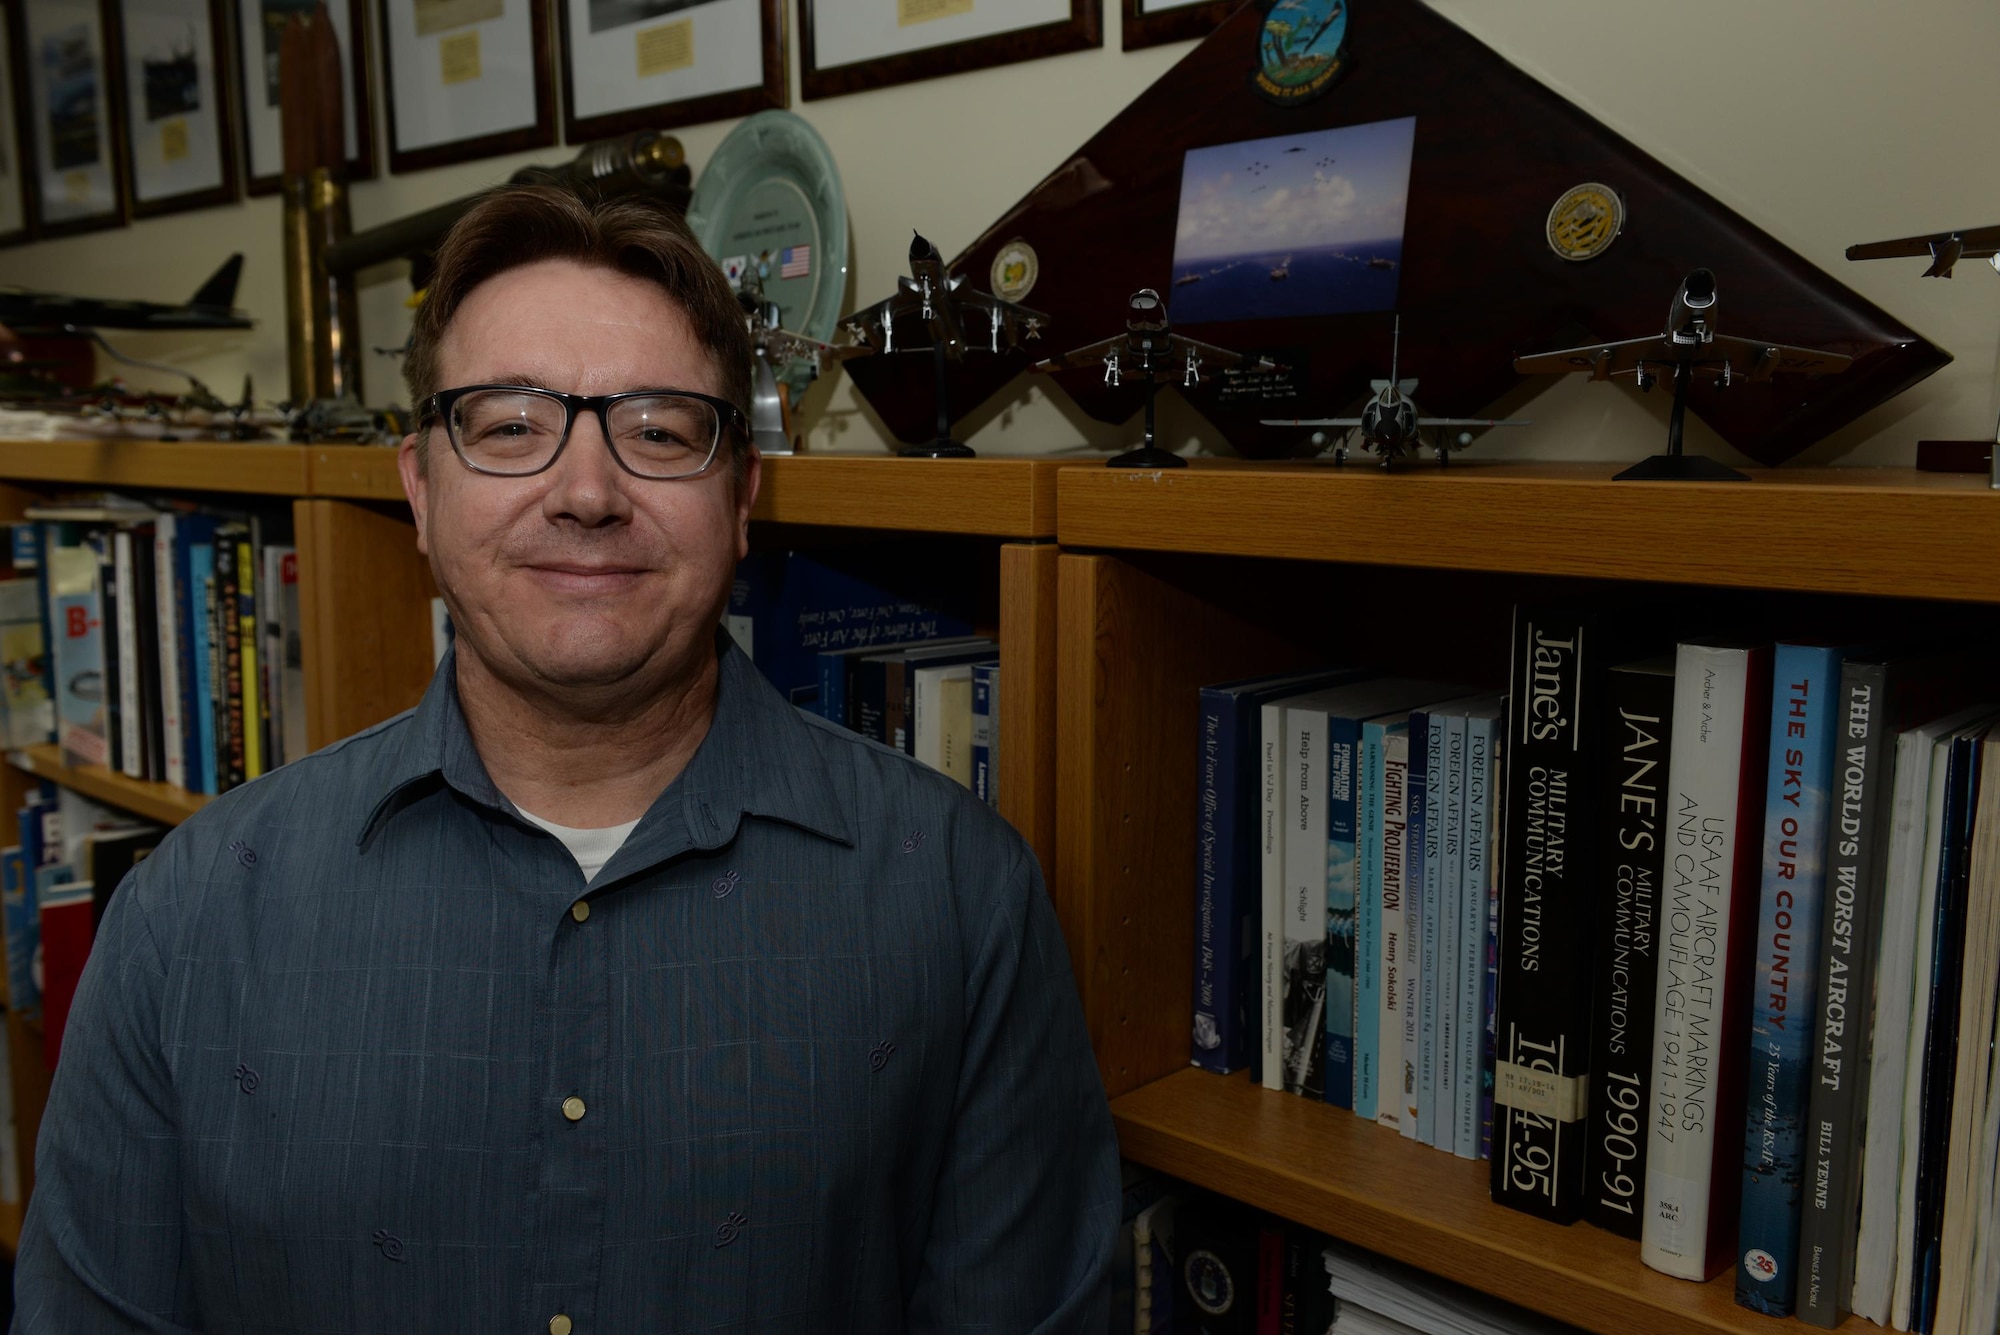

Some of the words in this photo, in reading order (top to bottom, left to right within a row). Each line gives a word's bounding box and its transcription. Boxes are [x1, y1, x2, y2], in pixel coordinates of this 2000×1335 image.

[831, 628, 850, 646] Air
[1531, 629, 1574, 741] Jane's
[1702, 668, 1716, 700] Archer
[1206, 714, 1219, 734] The
[1702, 702, 1711, 710] &
[1788, 679, 1809, 739] THE
[1848, 685, 1871, 739] THE
[1205, 736, 1218, 754] Air
[1299, 731, 1310, 759] Help
[1700, 712, 1713, 743] Archer
[1266, 742, 1274, 762] Pearl
[1332, 754, 1341, 769] the
[1333, 742, 1341, 753] of
[1428, 725, 1441, 794] FOREIGN
[1448, 732, 1462, 796] FOREIGN
[1204, 755, 1217, 786] Force
[1266, 764, 1273, 772] to
[1300, 763, 1309, 791] from
[1332, 770, 1341, 800] FORCE
[1340, 743, 1351, 802] FOUNDATION
[1385, 760, 1407, 815] FIGHTING
[1471, 736, 1485, 805] FOREIGN
[1618, 706, 1661, 852] JANE'S
[1783, 748, 1803, 808] SKY
[1203, 789, 1217, 820] Office
[1265, 788, 1273, 803] Day
[1299, 795, 1309, 831] Above
[1409, 794, 1420, 817] SSQ
[1838, 745, 1866, 856] WORLD'S
[1202, 822, 1216, 835] of
[1265, 810, 1274, 854] Proceedings
[1426, 796, 1440, 859] AFFAIRS
[1446, 798, 1460, 856] AFFAIRS
[1545, 768, 1568, 879] MILITARY
[1677, 792, 1699, 846] AND
[1202, 836, 1216, 873] Special
[1409, 823, 1420, 870] STRATEGIC
[1469, 808, 1482, 871] AFFAIRS
[1699, 817, 1725, 896] USAAF
[1778, 817, 1798, 880] OUR
[1383, 820, 1406, 911] PROLIFERATION
[1520, 766, 1547, 972] COMMUNICATIONS
[1200, 873, 1215, 943] Investigations
[1298, 886, 1308, 922] Schlight
[1408, 874, 1419, 911] STUDIES
[1633, 866, 1653, 957] MILITARY
[1832, 864, 1857, 954] WORST
[1387, 932, 1398, 963] Henry
[1407, 913, 1419, 965] QUARTERLY
[1665, 854, 1695, 1021] CAMOUFLAGE
[1690, 899, 1718, 1010] AIRCRAFT
[1201, 945, 1214, 970] 1948
[1423, 949, 1432, 974] 2005
[1467, 943, 1476, 997] FEBRUARY
[1609, 864, 1634, 1055] COMMUNICATIONS
[1769, 890, 1793, 1031] COUNTRY
[1200, 981, 1213, 1006] 2000
[1387, 966, 1397, 1011] Sokolski
[1406, 978, 1416, 1017] WINTER
[1405, 1020, 1415, 1043] 2011
[1422, 1022, 1432, 1033] 84
[1465, 1000, 1474, 1025] 2005
[1821, 955, 1848, 1091] AIRCRAFT
[1422, 1039, 1430, 1082] NUMBER
[1768, 1041, 1781, 1059] 25
[1657, 1030, 1681, 1143] 1941-1947
[1682, 1013, 1710, 1133] MARKINGS
[1767, 1060, 1780, 1092] Years
[1463, 1090, 1471, 1134] NUMBER
[1762, 1093, 1777, 1109] of
[1764, 1108, 1777, 1126] the
[1601, 1071, 1641, 1215] 1990-91
[1762, 1128, 1775, 1166] RSAF
[1819, 1121, 1833, 1156] BILL
[1814, 1159, 1830, 1209] YENNE
[1756, 1255, 1774, 1274] 25
[1811, 1246, 1823, 1274] BARNES
[1811, 1274, 1821, 1283] &
[1808, 1283, 1820, 1309] NOBLE
